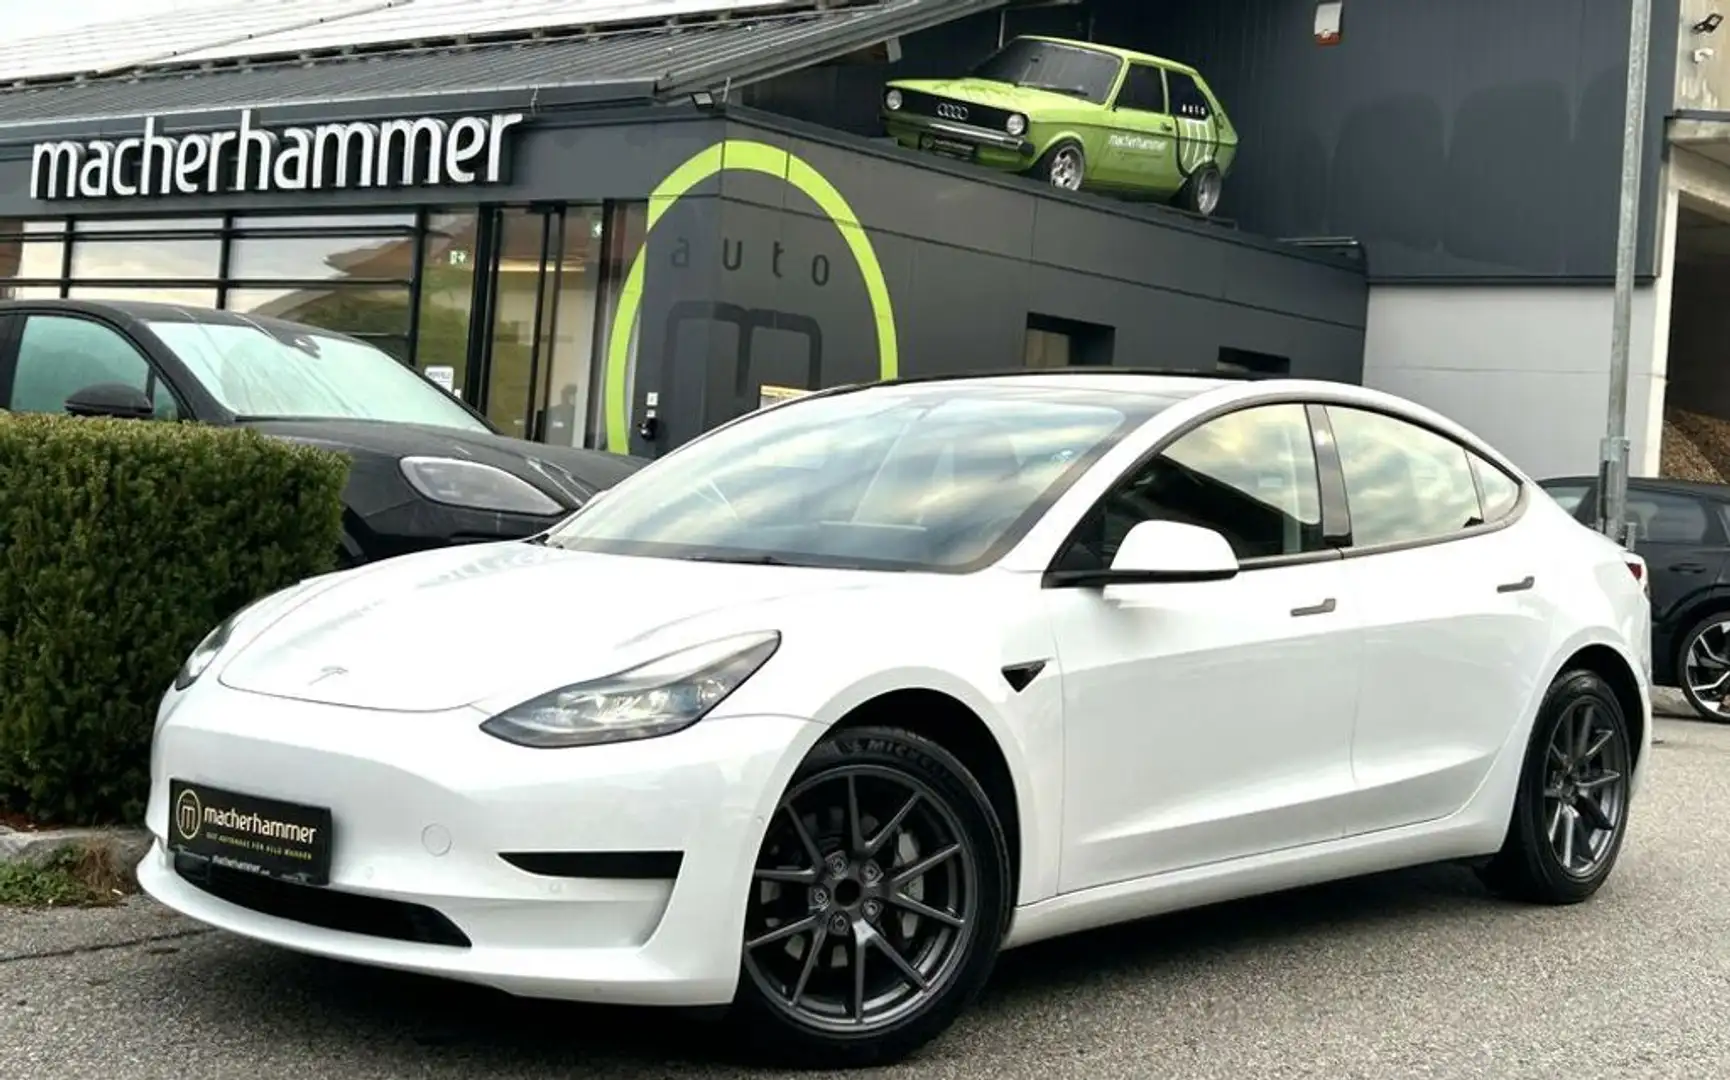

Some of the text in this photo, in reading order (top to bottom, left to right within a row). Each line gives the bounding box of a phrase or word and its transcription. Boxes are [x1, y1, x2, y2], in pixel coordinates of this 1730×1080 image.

[30, 110, 523, 198] macherhammer
[670, 236, 831, 287] auto
[204, 807, 317, 844] macherhammer
